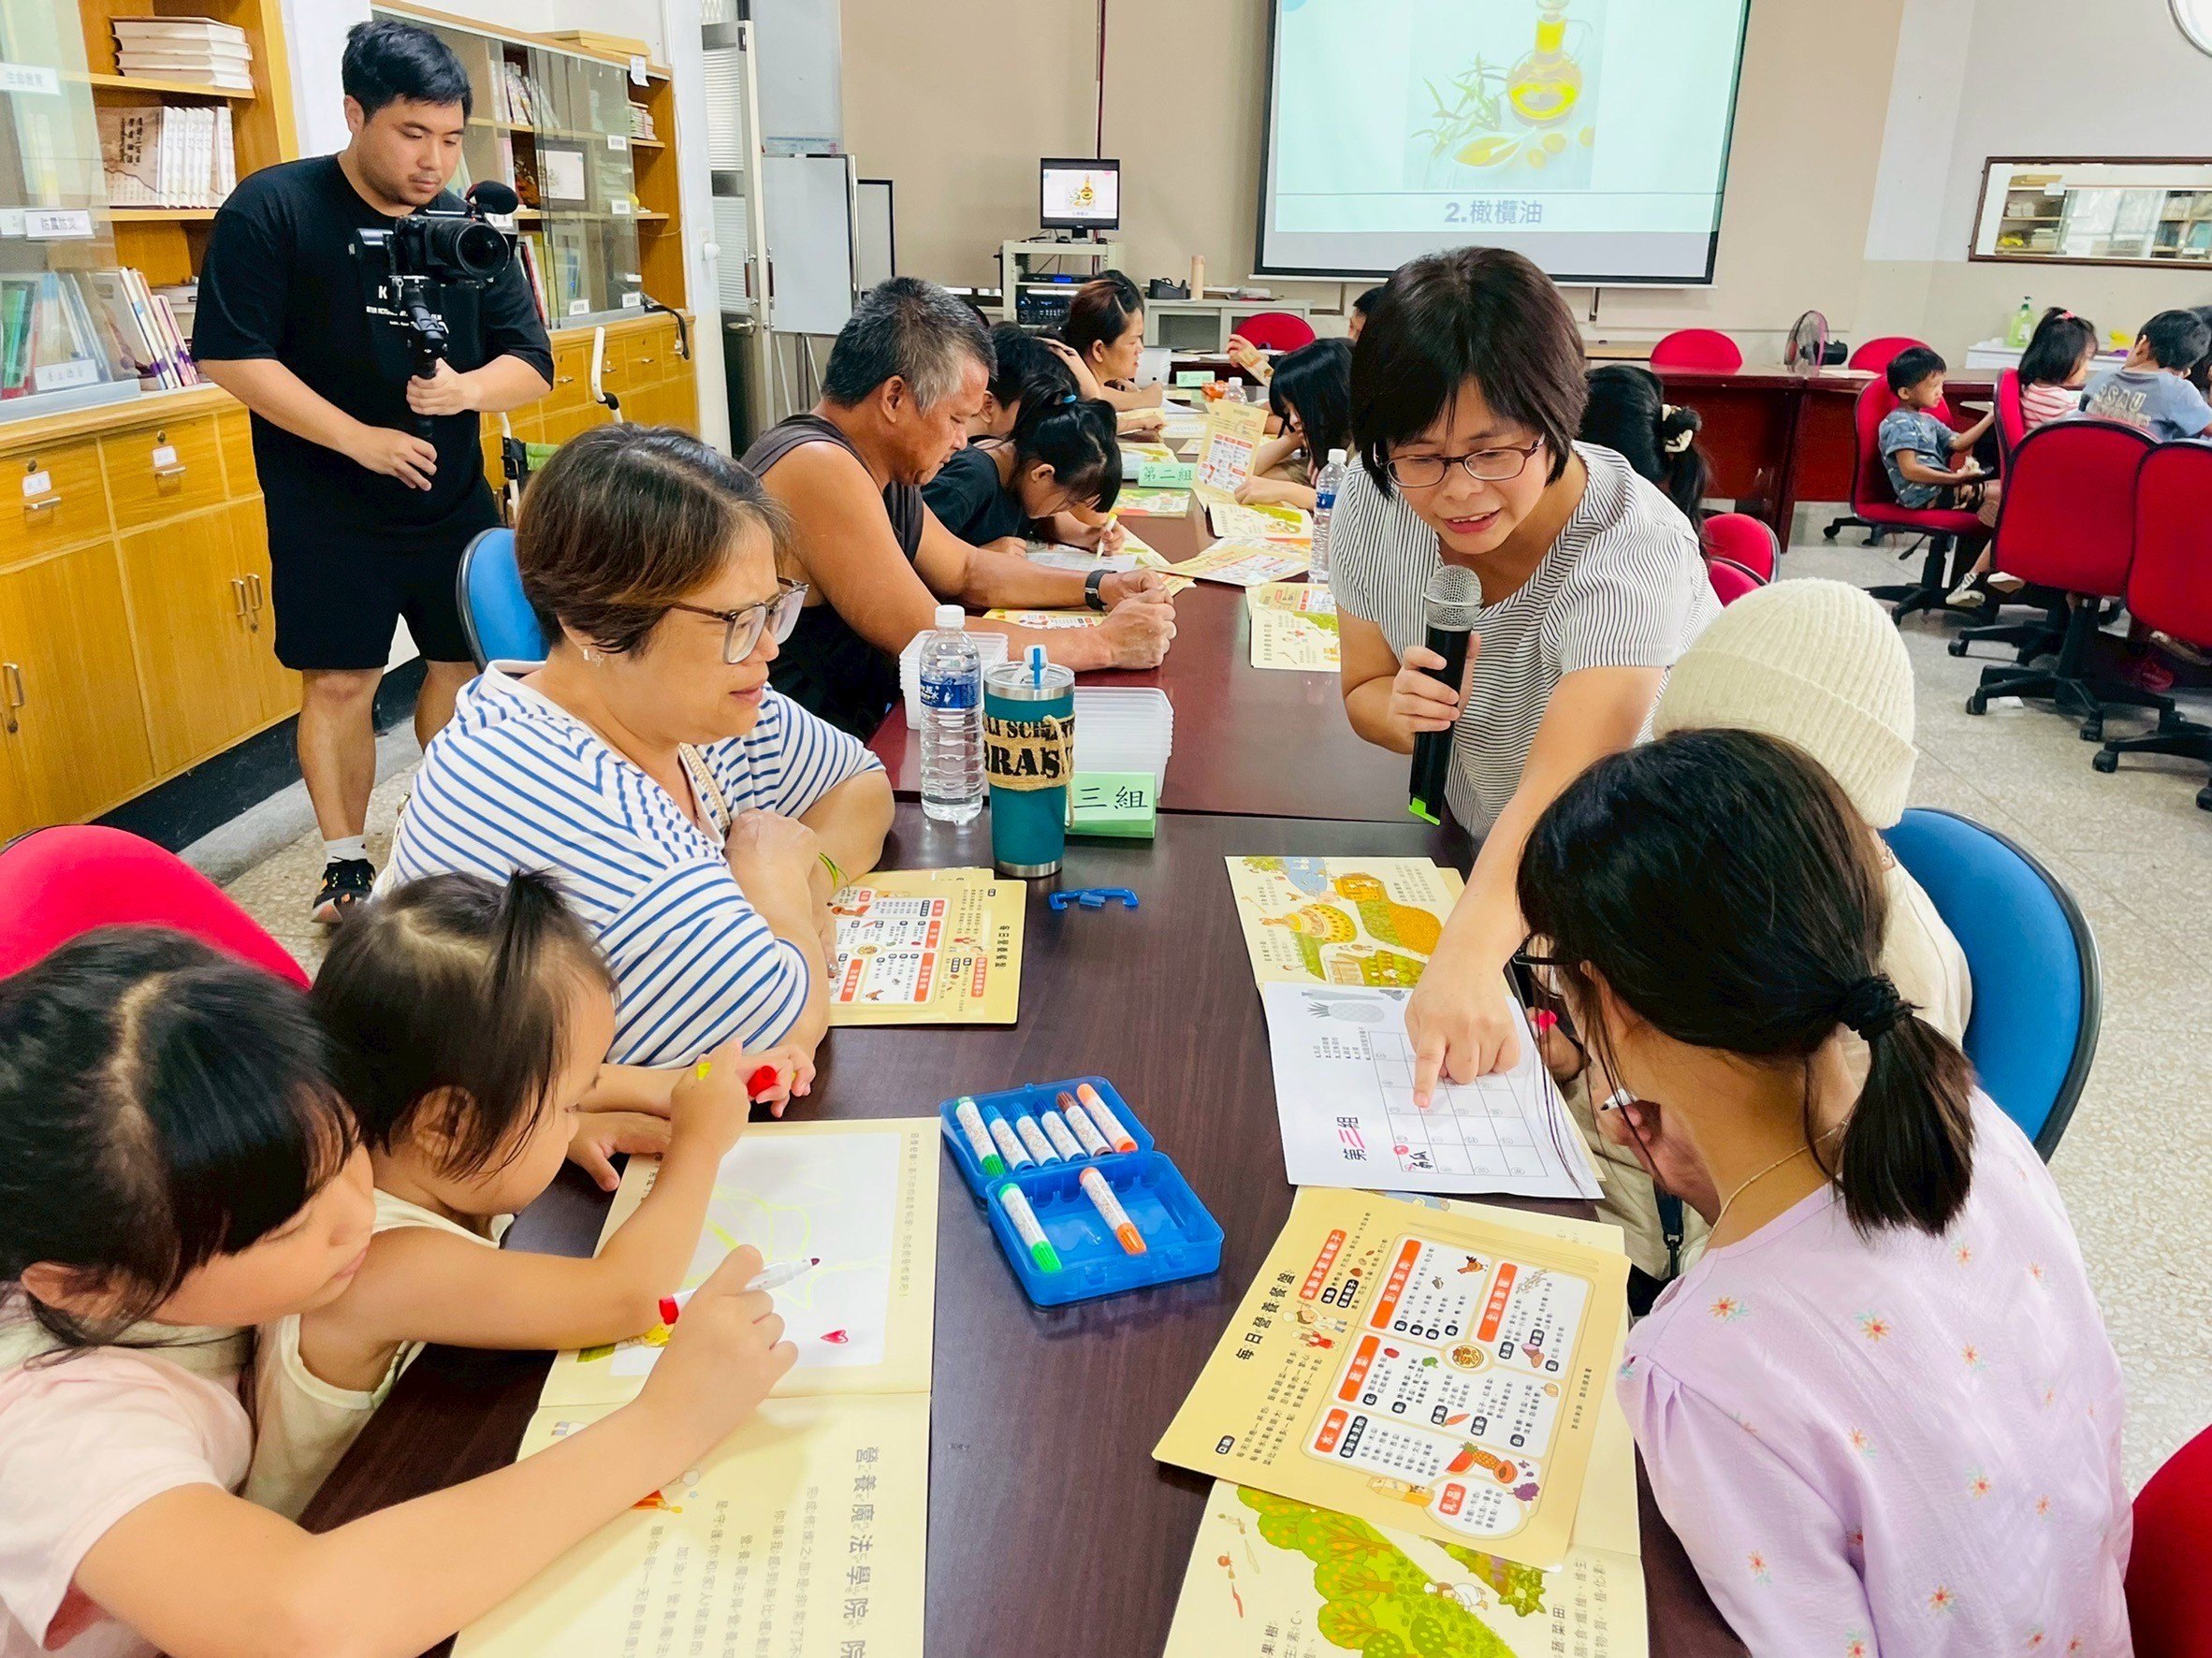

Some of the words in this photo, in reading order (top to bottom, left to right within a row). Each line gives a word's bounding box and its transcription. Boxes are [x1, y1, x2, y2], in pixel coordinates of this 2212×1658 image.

[1445, 200, 1543, 224] 2.橄欖油
[1144, 466, 1193, 481] 第二組
[1073, 787, 1148, 810] 三組
[1235, 1269, 1296, 1360] 每日營養餐盤
[844, 1447, 880, 1619] 營養魔法學院
